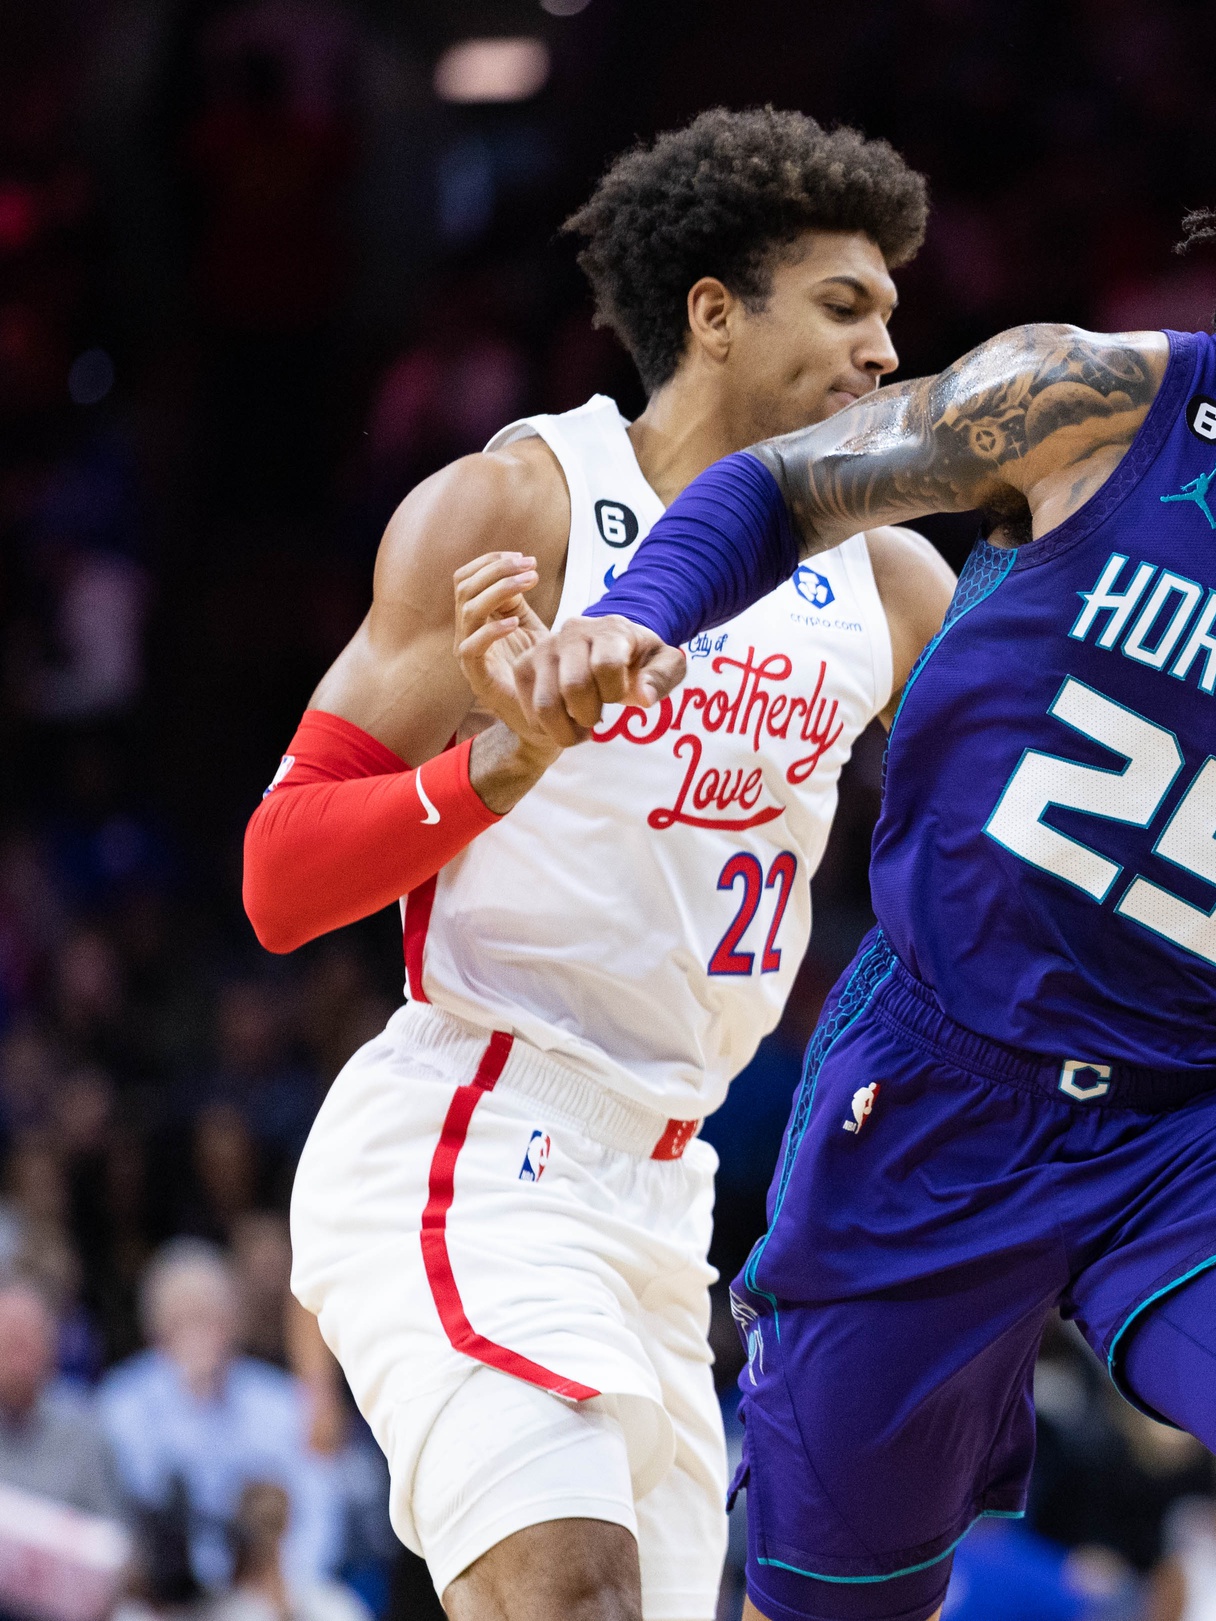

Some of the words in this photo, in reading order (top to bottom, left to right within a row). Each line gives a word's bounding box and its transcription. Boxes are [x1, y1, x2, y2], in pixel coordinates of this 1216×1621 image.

[600, 505, 627, 544] 6
[789, 612, 863, 633] crypto.com
[714, 633, 729, 652] of
[647, 733, 787, 831] Love
[707, 850, 798, 977] 22
